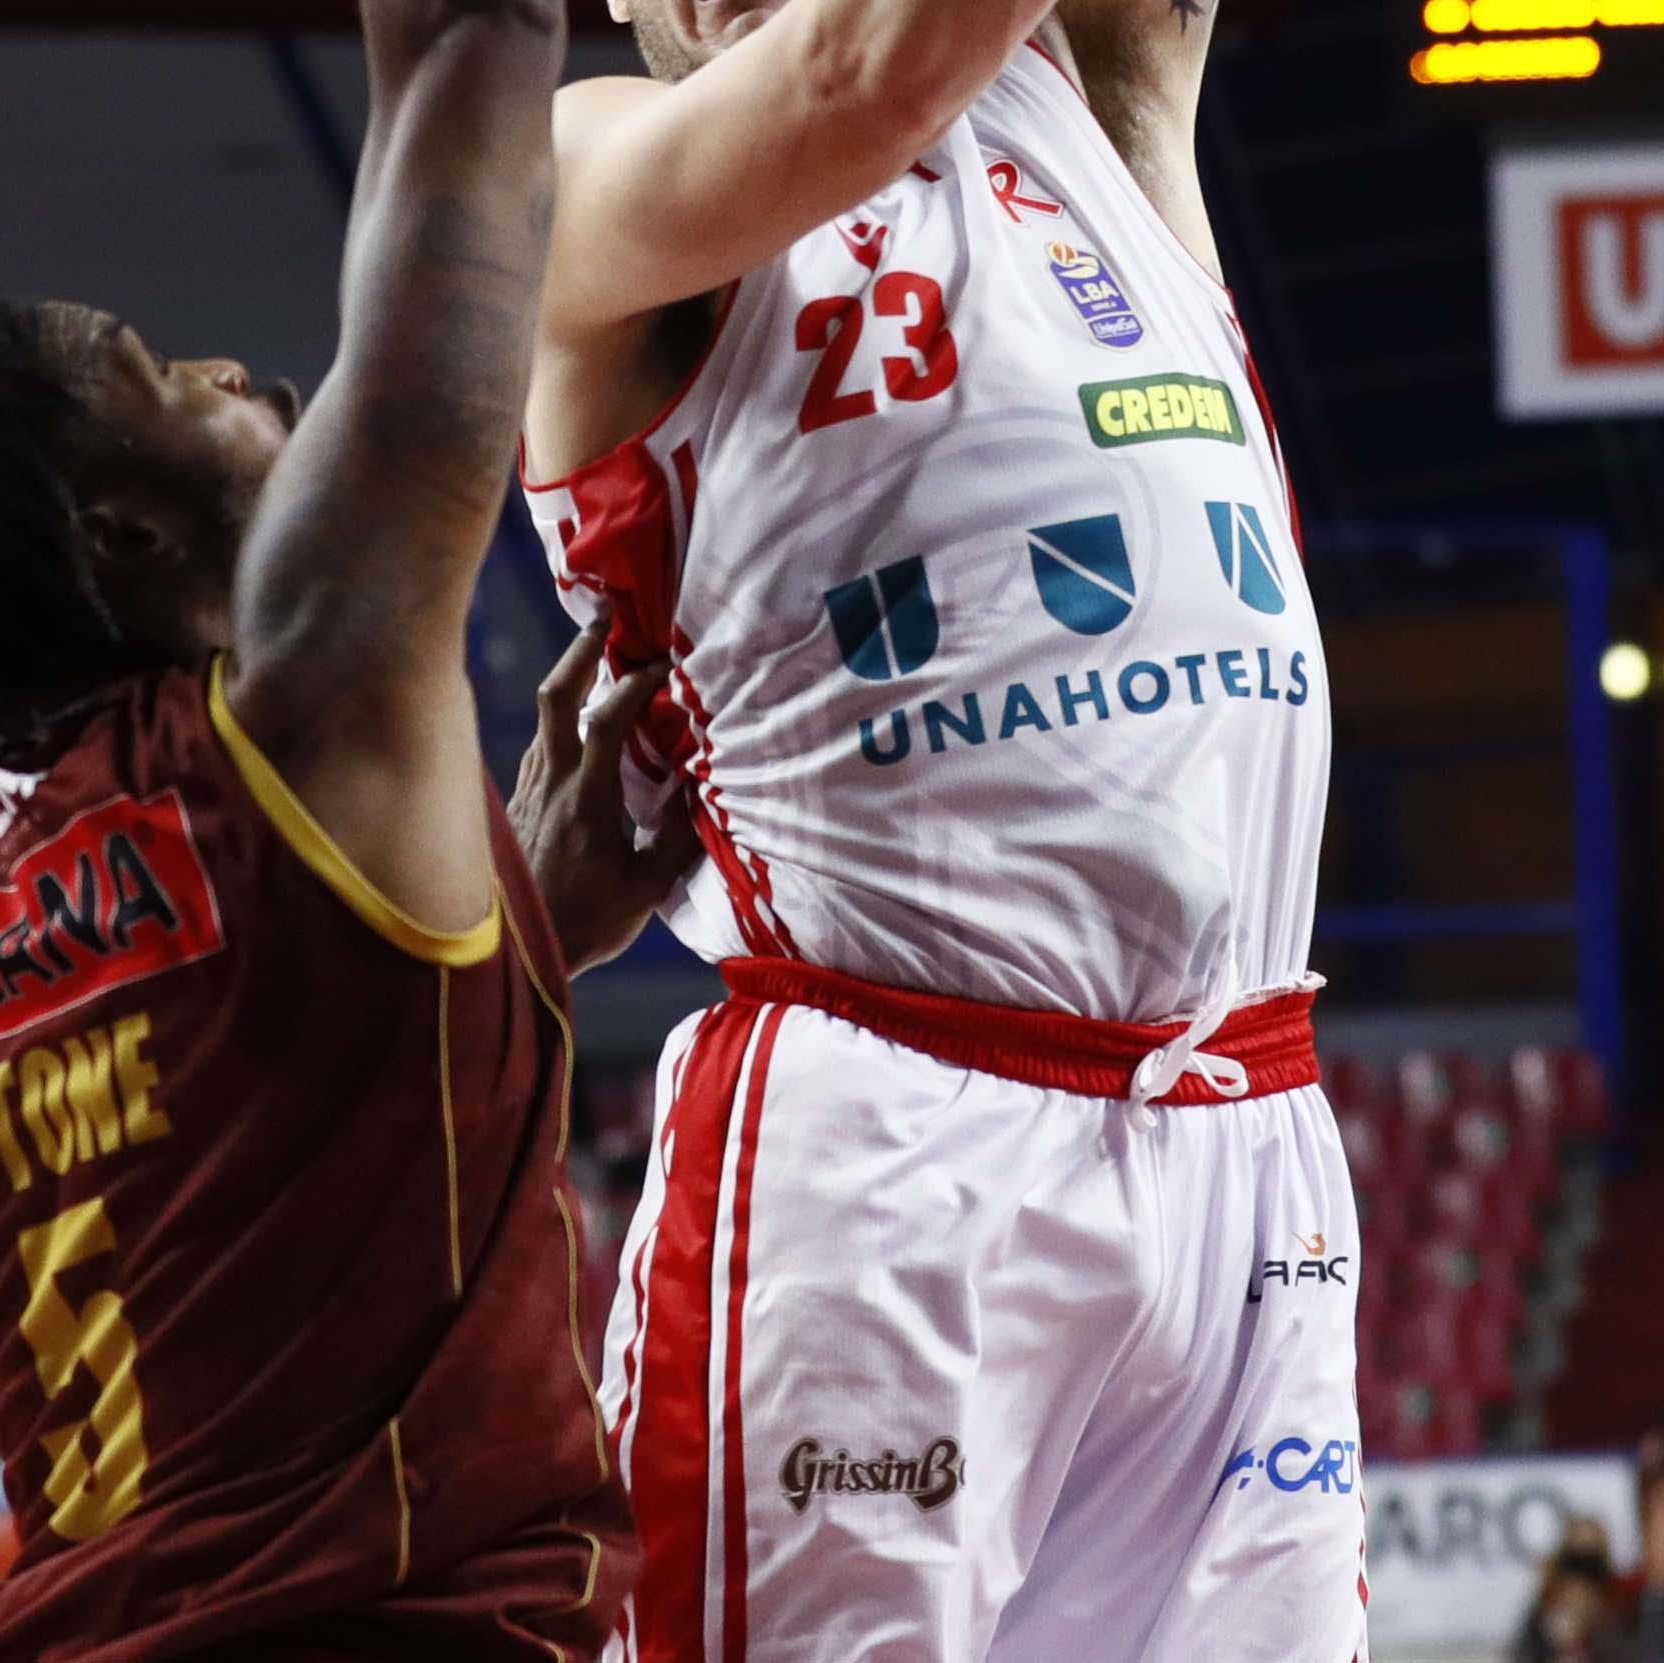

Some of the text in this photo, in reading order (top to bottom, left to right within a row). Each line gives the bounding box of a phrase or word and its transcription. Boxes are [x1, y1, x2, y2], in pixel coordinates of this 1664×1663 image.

[794, 271, 959, 435] 23
[1069, 279, 1120, 305] LBA
[858, 646, 1310, 767] UNAHOTELS
[18, 1196, 150, 1540] 5
